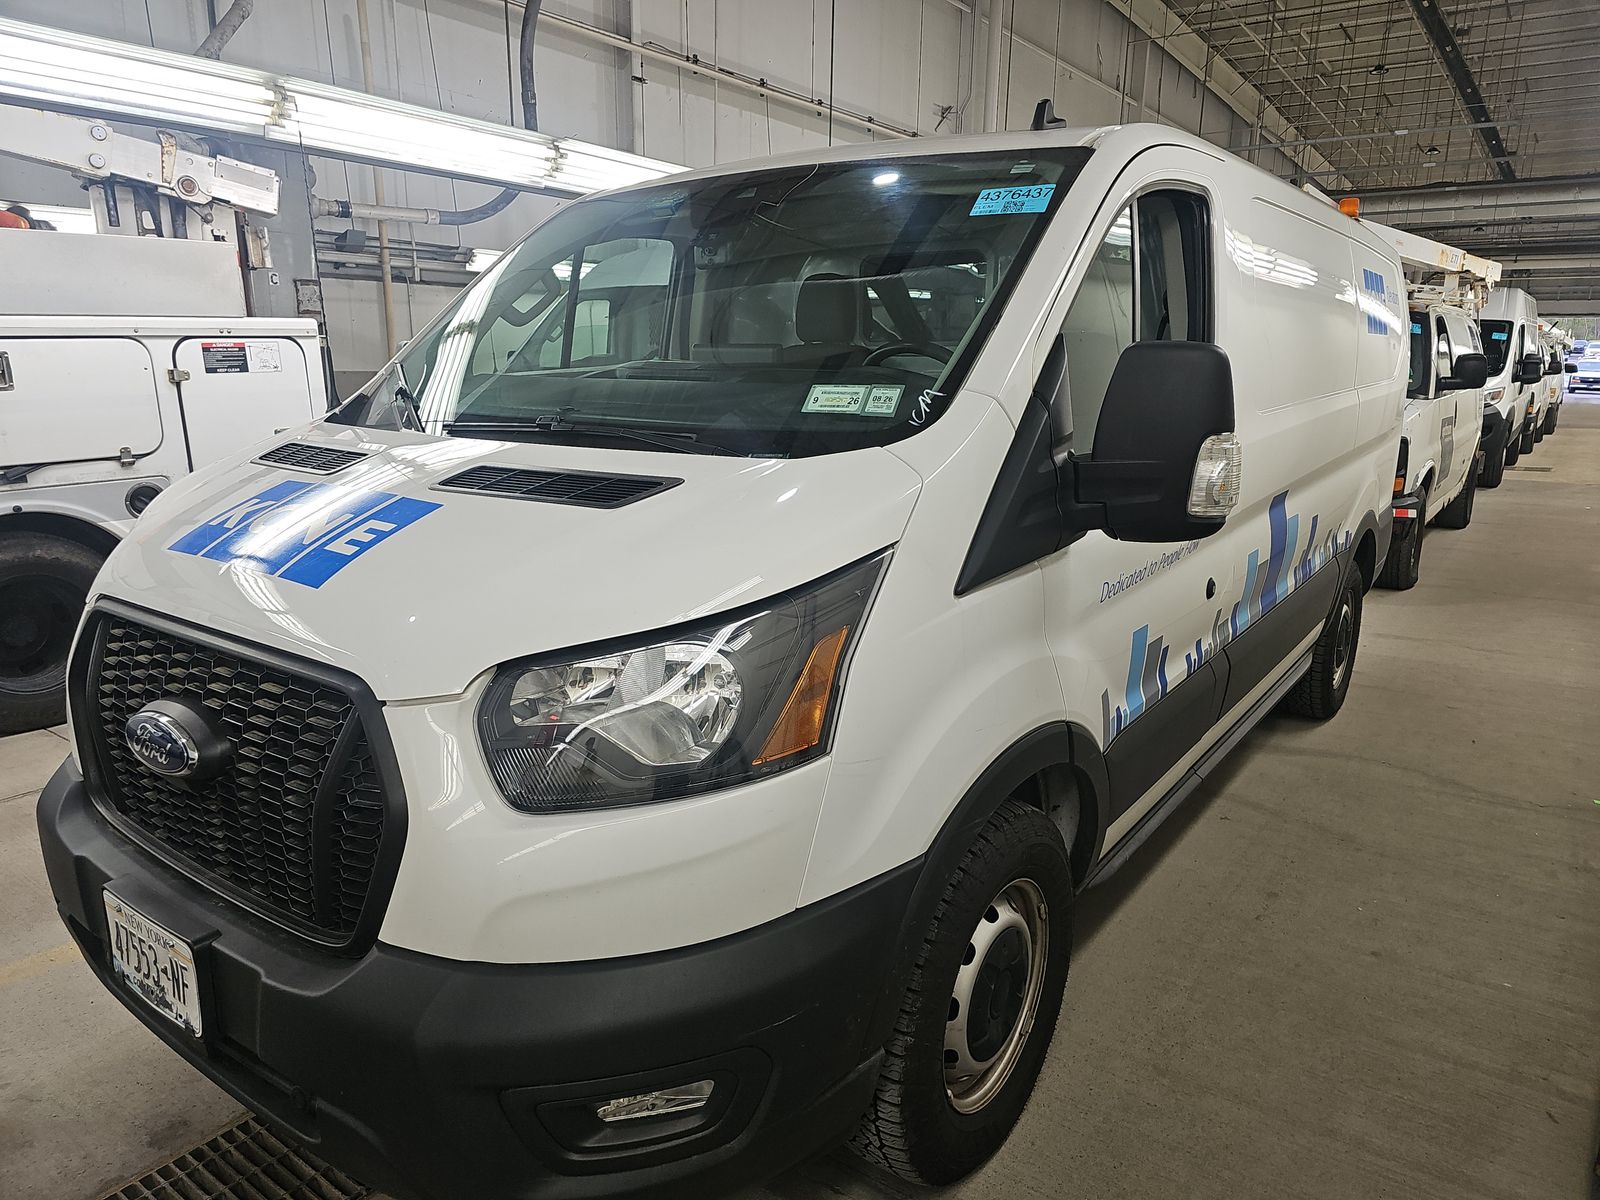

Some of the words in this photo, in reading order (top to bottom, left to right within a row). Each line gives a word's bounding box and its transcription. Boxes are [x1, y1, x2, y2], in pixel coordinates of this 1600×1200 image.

[981, 187, 1055, 202] 4376437
[812, 396, 819, 404] 9
[847, 396, 860, 405] 26
[1100, 560, 1149, 604] Dedicated
[1147, 560, 1158, 577] to
[1157, 543, 1185, 571] People
[133, 722, 172, 765] Ford
[124, 911, 144, 933] NEW
[144, 924, 171, 949] YORK
